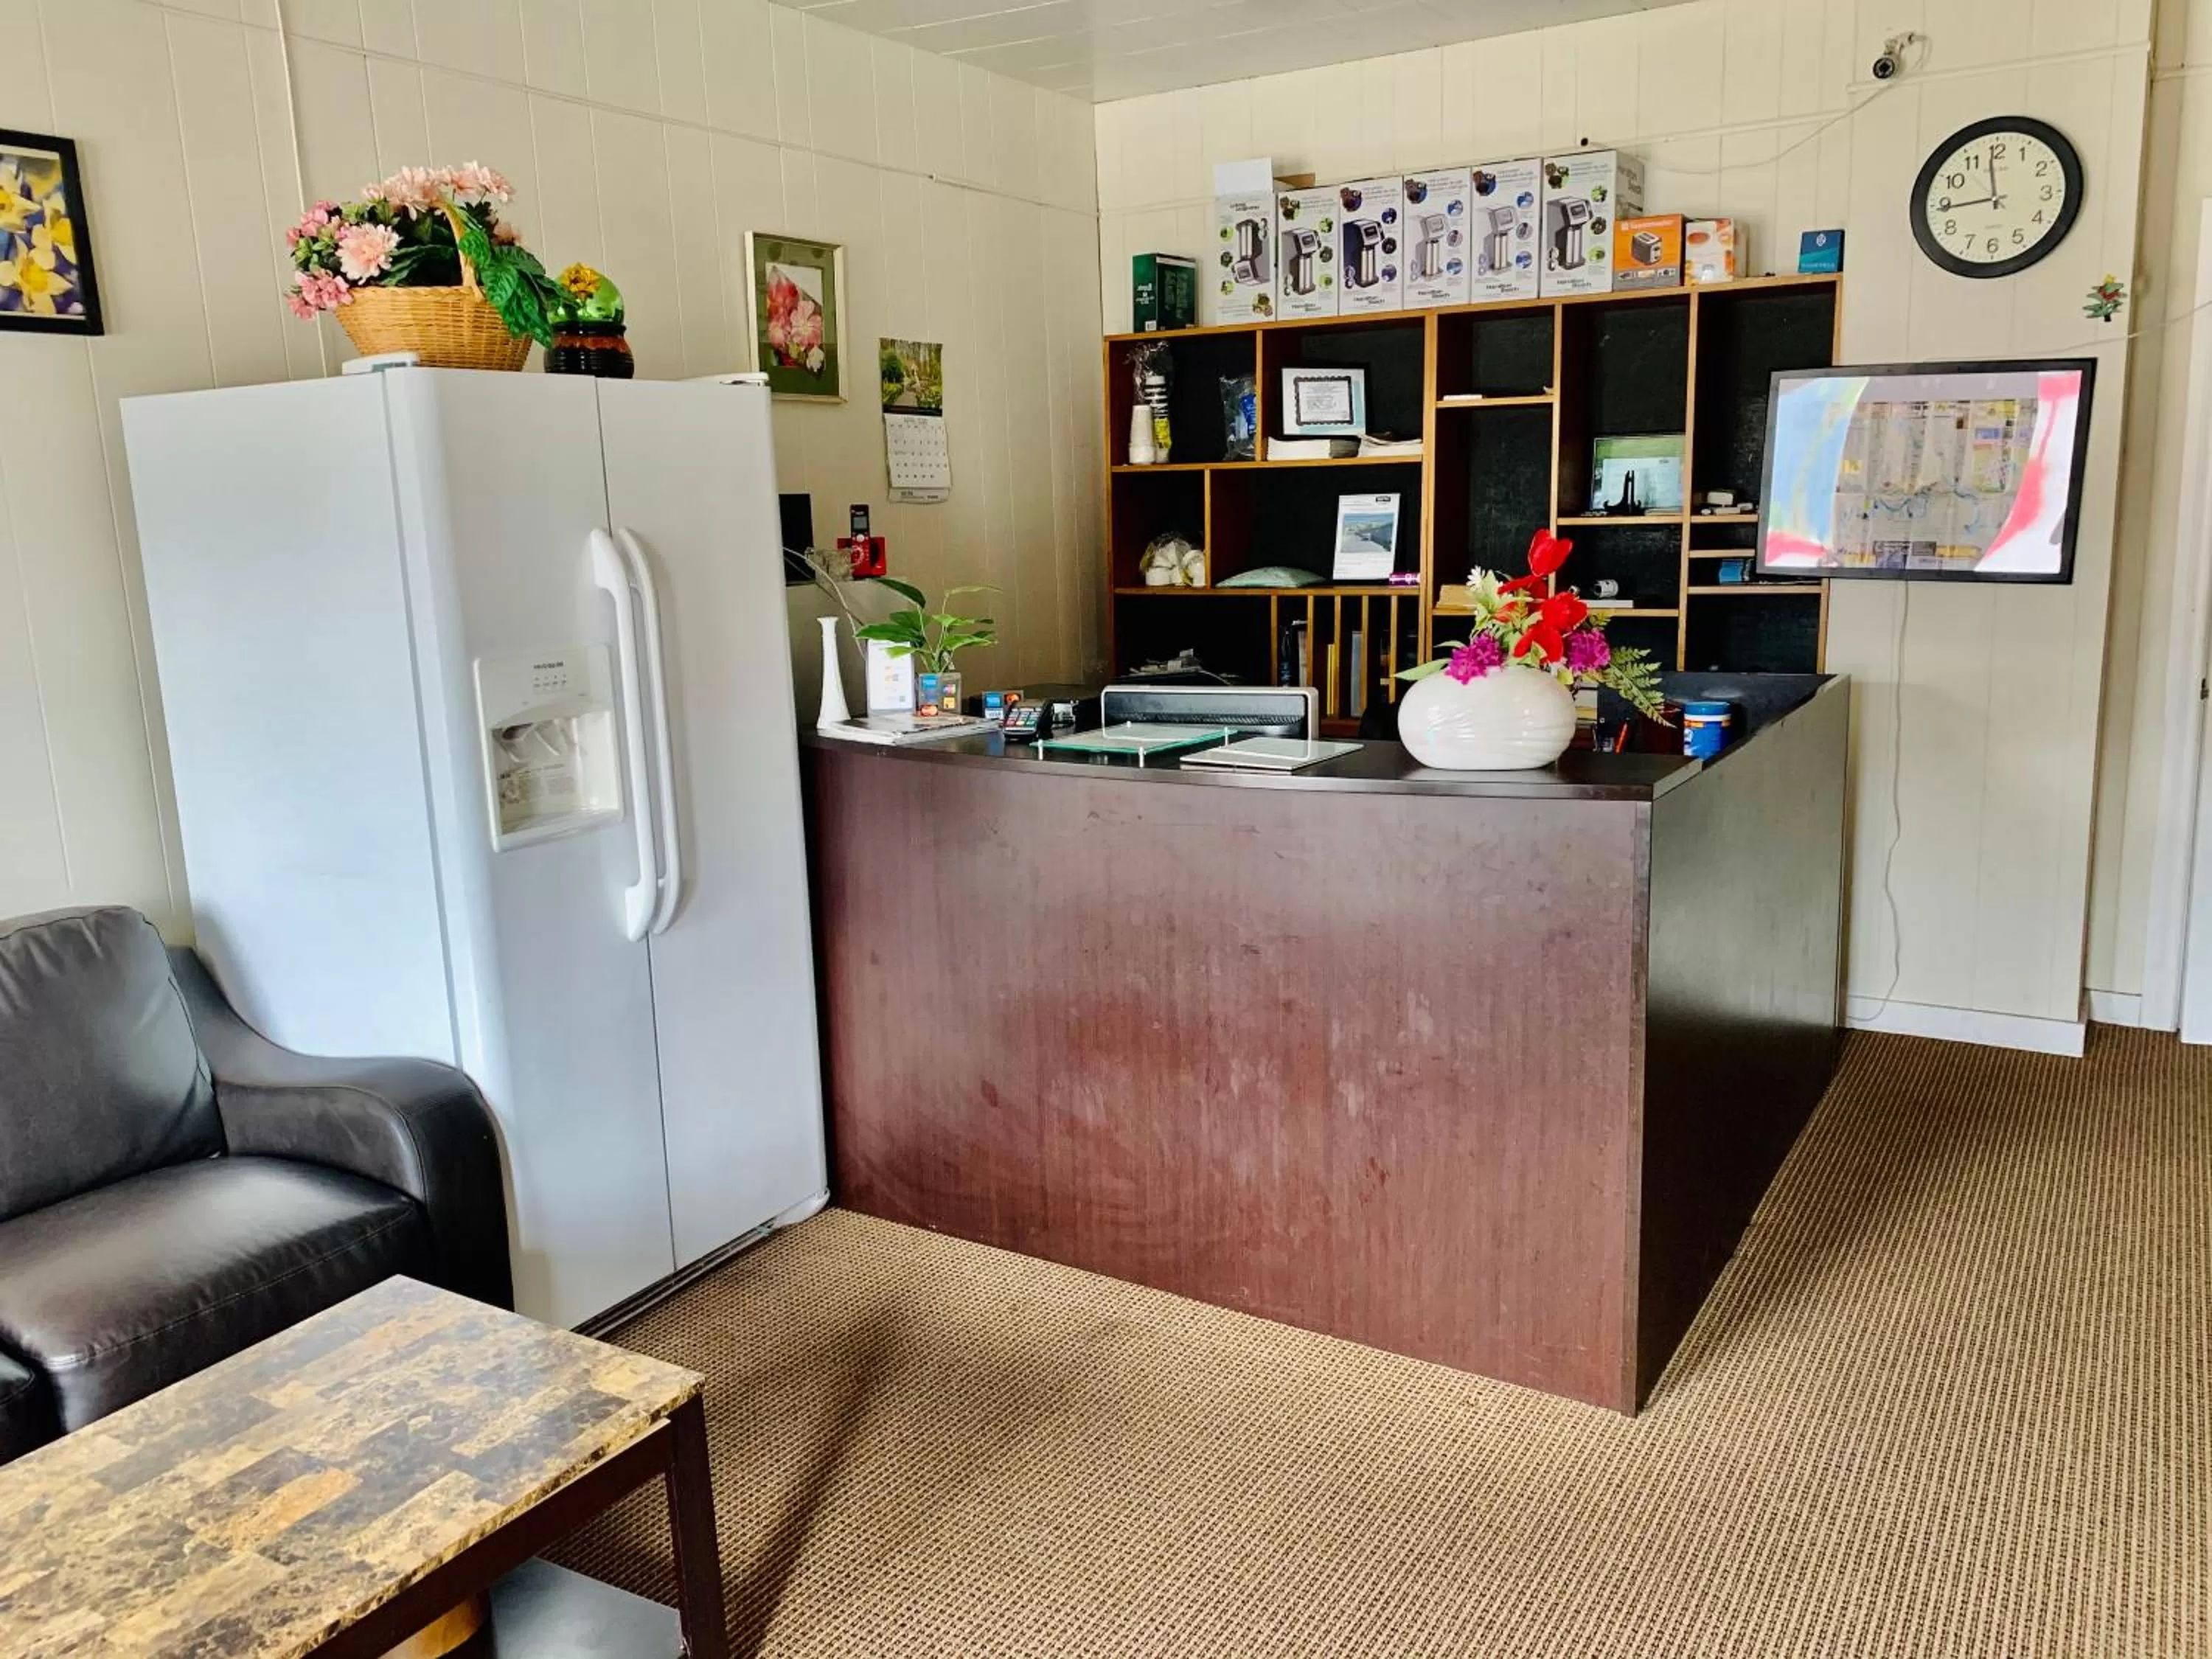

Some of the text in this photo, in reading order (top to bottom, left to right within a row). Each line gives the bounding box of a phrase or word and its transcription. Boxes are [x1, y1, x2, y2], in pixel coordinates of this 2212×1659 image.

[1989, 143, 2006, 160] 12
[2019, 147, 2026, 161] 1
[1964, 154, 1979, 170] 11
[2035, 161, 2048, 178] 2
[1946, 173, 1965, 189] 10
[2040, 184, 2053, 201] 3
[1939, 197, 1952, 212] 9
[2031, 209, 2044, 224] 4
[1944, 219, 1957, 235] 8
[1964, 234, 1977, 249] 7
[2011, 229, 2024, 244] 5
[1986, 237, 1999, 254] 6
